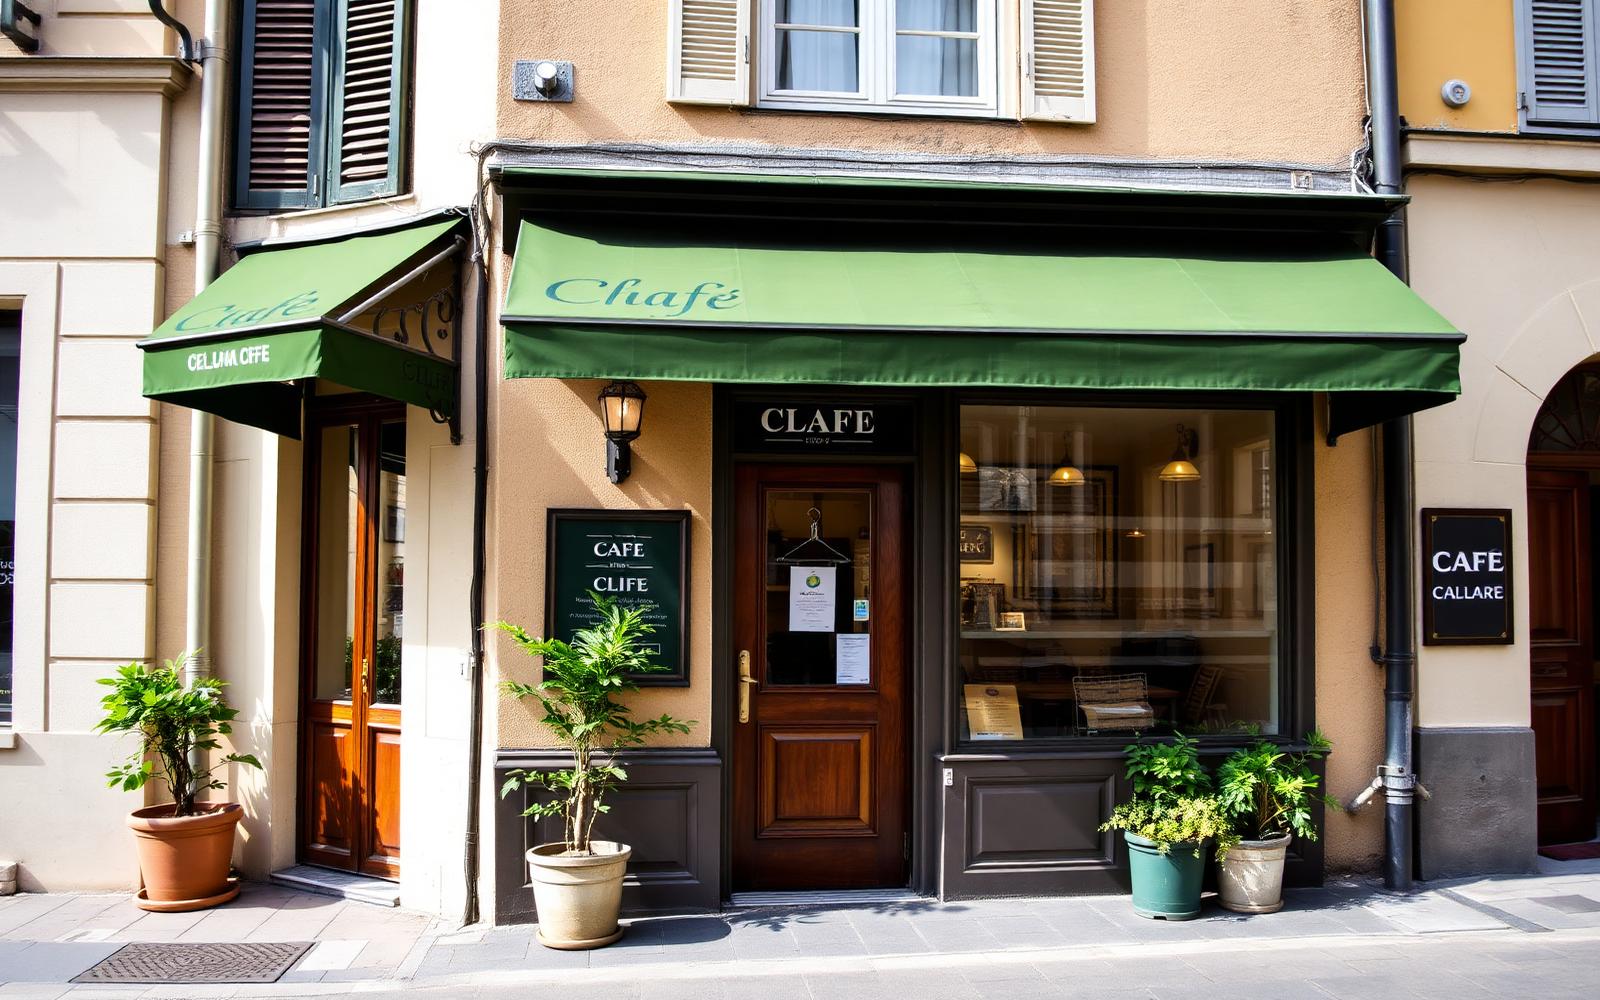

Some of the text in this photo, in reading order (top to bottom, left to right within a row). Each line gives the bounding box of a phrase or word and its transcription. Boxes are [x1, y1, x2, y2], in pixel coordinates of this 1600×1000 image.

[760, 407, 876, 434] CLAFE
[593, 541, 645, 558] CAFE
[593, 576, 649, 592] CLIFE
[1432, 585, 1504, 600] CALLARE
